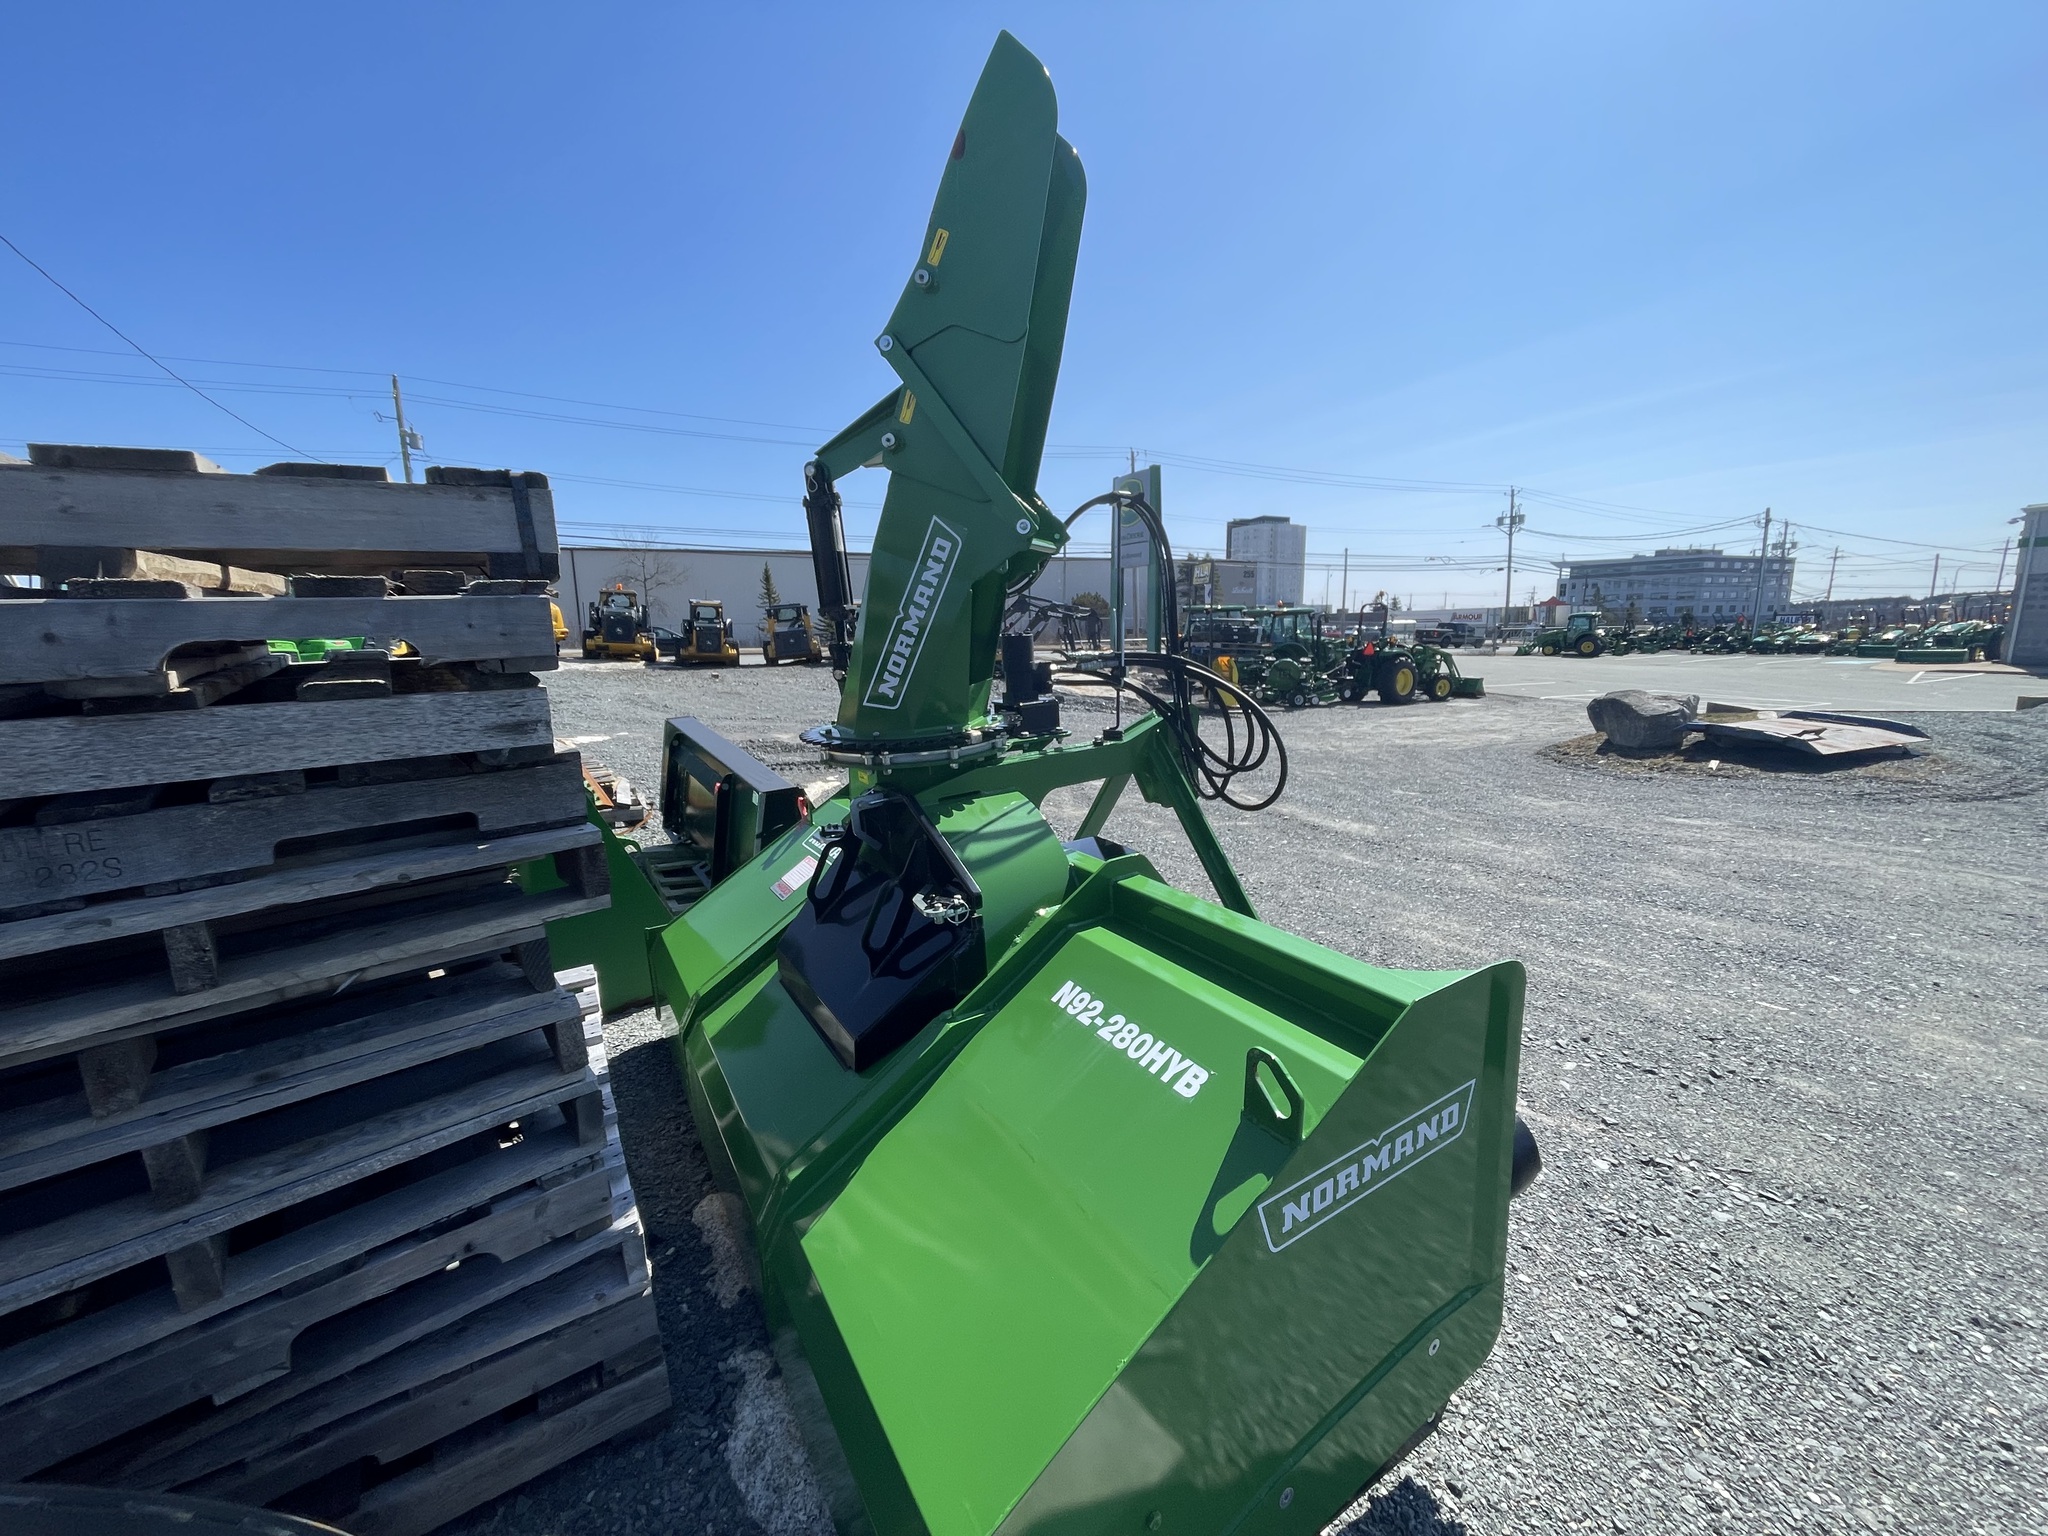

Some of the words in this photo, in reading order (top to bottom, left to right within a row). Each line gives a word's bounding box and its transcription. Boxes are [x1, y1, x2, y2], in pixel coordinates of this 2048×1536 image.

[878, 536, 952, 699] NORMAND
[1050, 980, 1209, 1098] N92-280HYB
[1282, 1102, 1459, 1233] NORMAND
